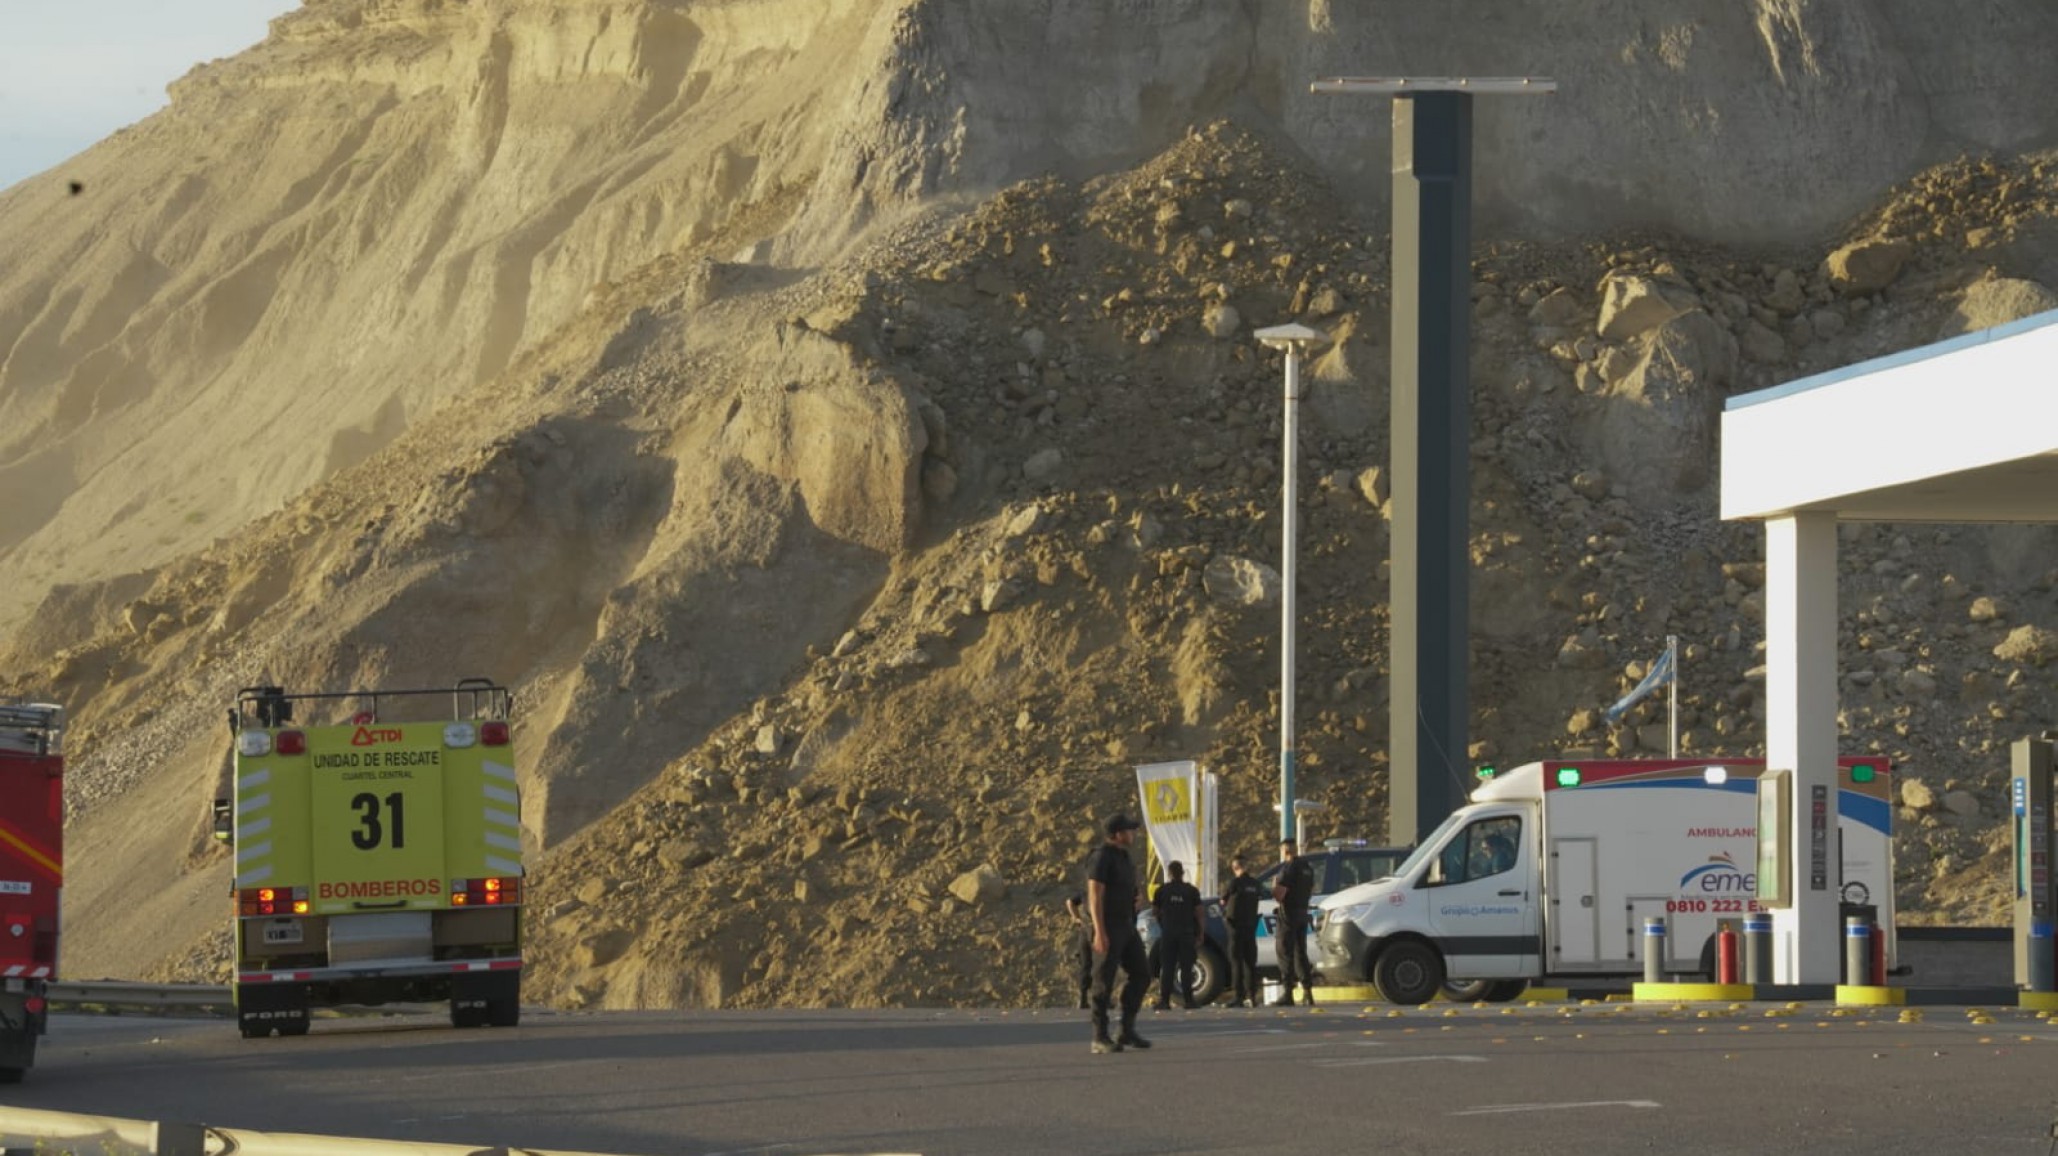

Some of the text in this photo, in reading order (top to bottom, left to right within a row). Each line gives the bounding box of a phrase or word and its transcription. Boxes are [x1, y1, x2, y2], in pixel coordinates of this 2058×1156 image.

[314, 751, 439, 768] UNIDAD DE RESCATE
[342, 770, 413, 780] CUARTEL CENTRAL
[351, 792, 404, 851] 31
[319, 879, 441, 899] BOMBEROS
[1666, 900, 1706, 913] 0810
[1712, 900, 1742, 912] 222
[243, 1010, 303, 1020] FORD
